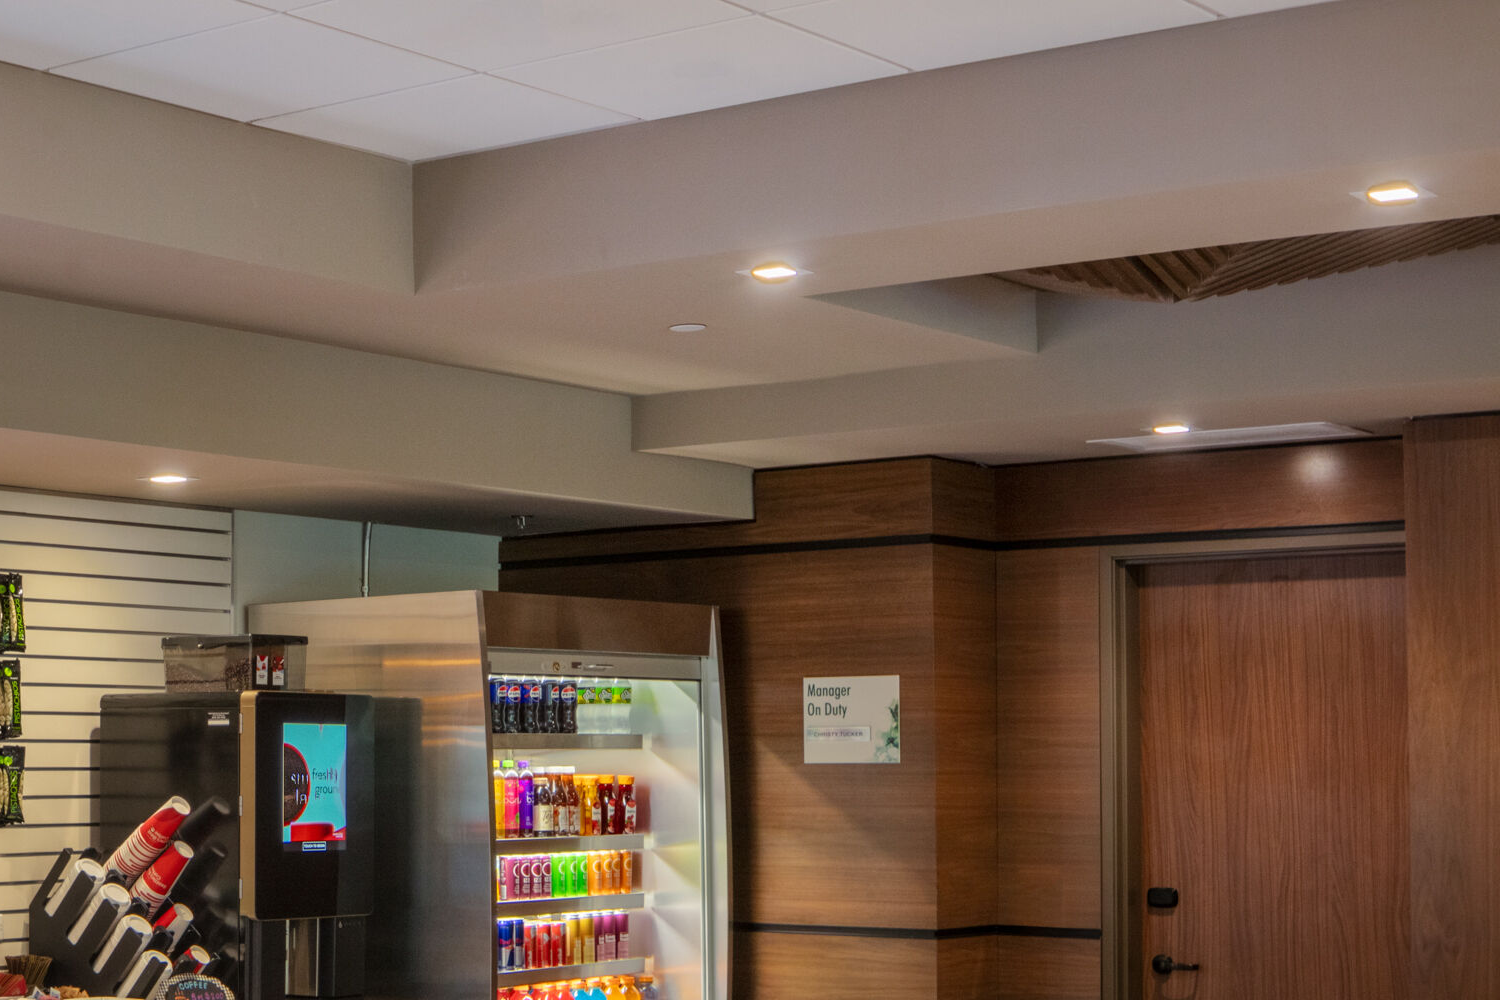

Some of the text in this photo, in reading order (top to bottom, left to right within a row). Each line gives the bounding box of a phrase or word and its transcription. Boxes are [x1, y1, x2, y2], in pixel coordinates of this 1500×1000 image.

[807, 683, 851, 700] Manager
[807, 702, 847, 719] On Duty
[179, 981, 208, 990] COFFEE
